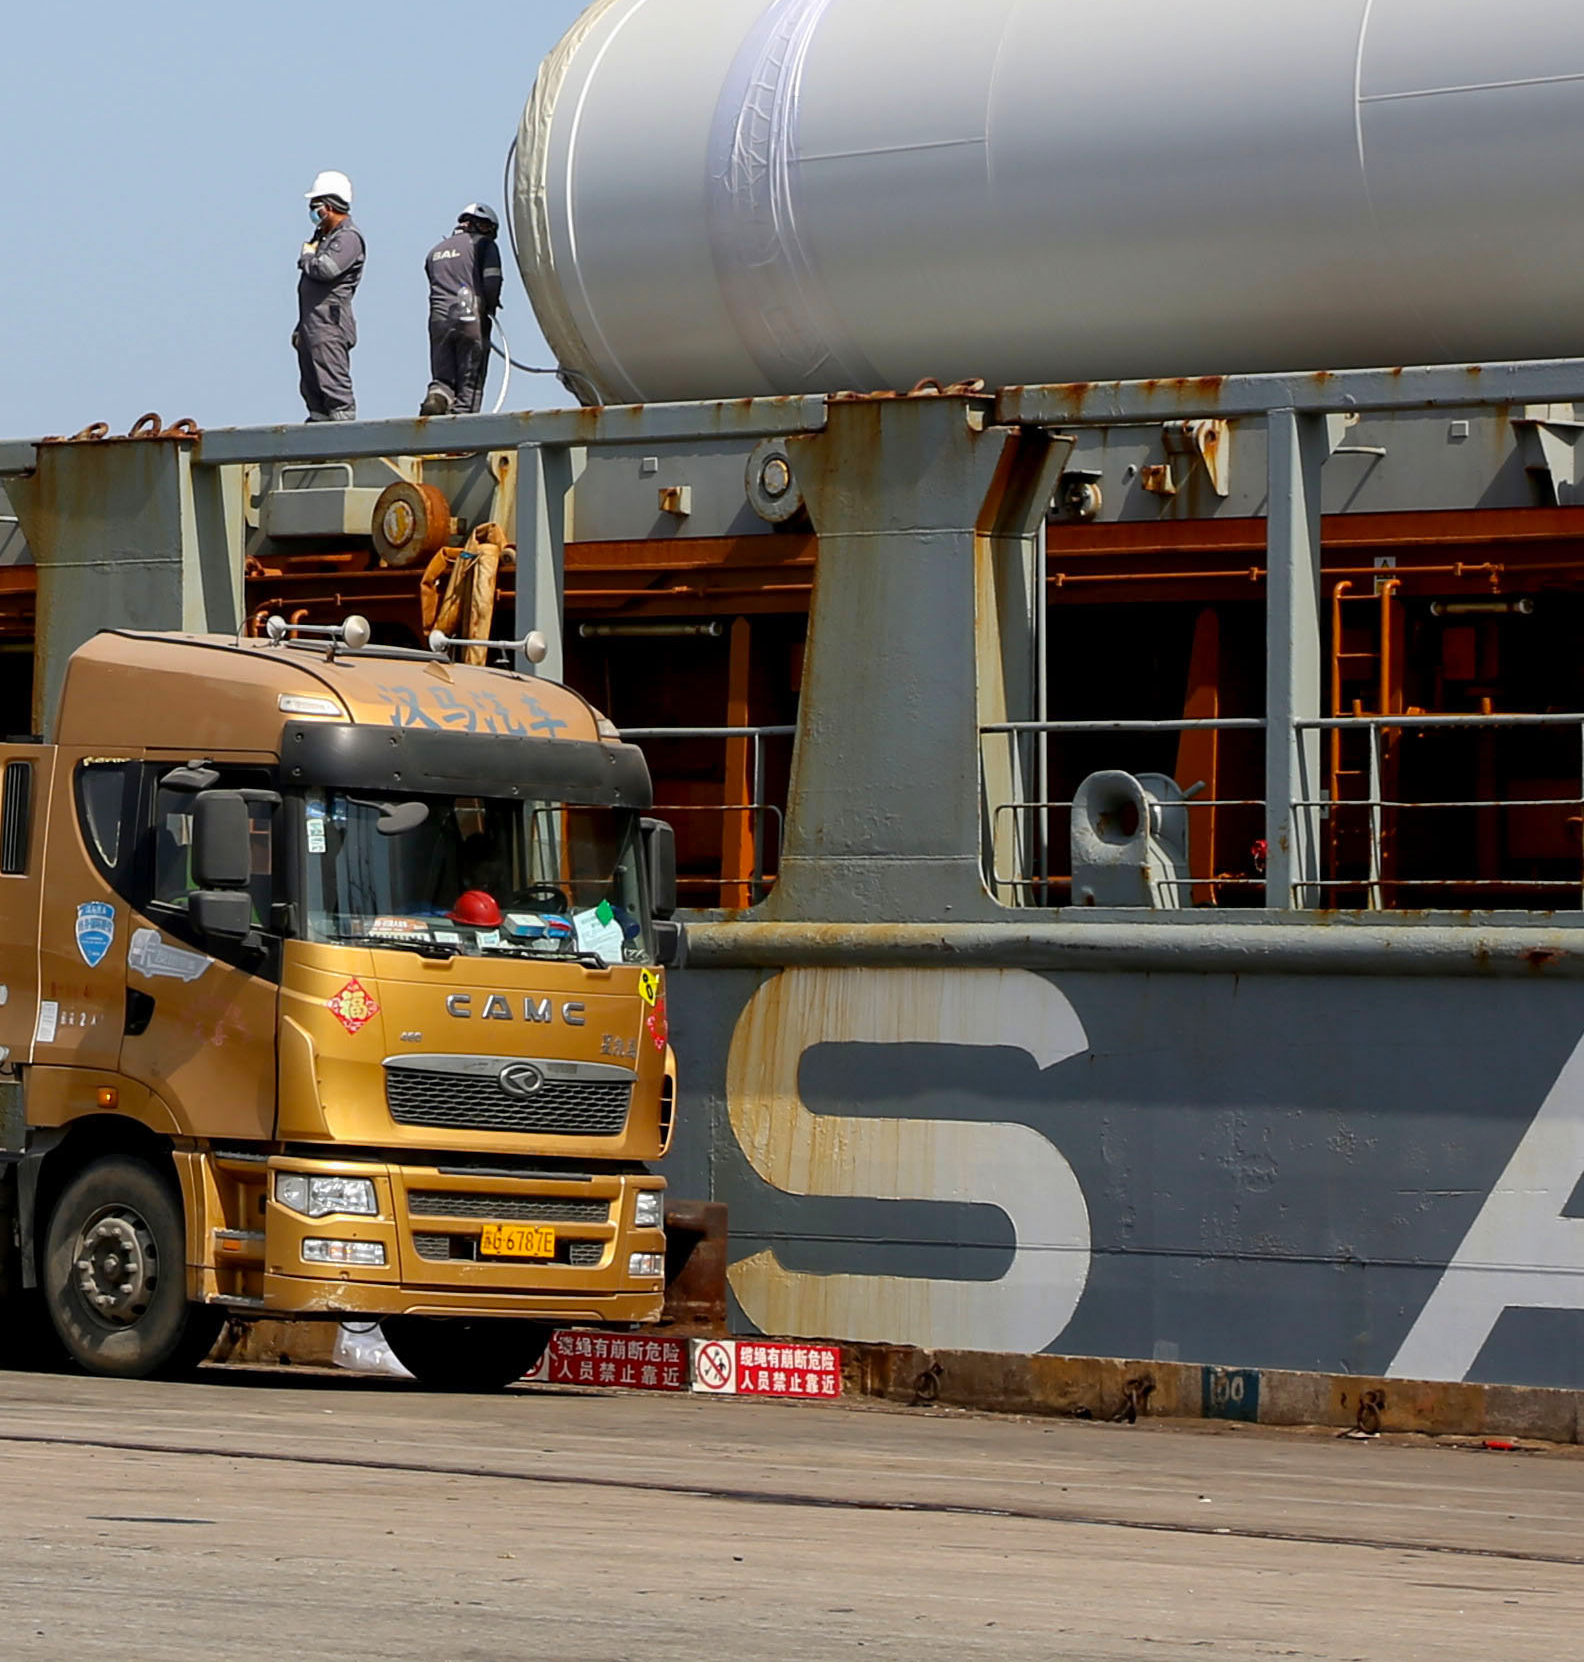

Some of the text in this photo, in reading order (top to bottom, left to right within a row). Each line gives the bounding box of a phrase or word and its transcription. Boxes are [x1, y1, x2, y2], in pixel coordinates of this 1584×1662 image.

[445, 993, 586, 1027] CAMC
[557, 1336, 681, 1363] 缆绳有崩断危险
[740, 1346, 835, 1371] 缆绳有崩断危险
[557, 1360, 681, 1387] 人员禁止靠近
[740, 1370, 835, 1395] 人员禁止靠近
